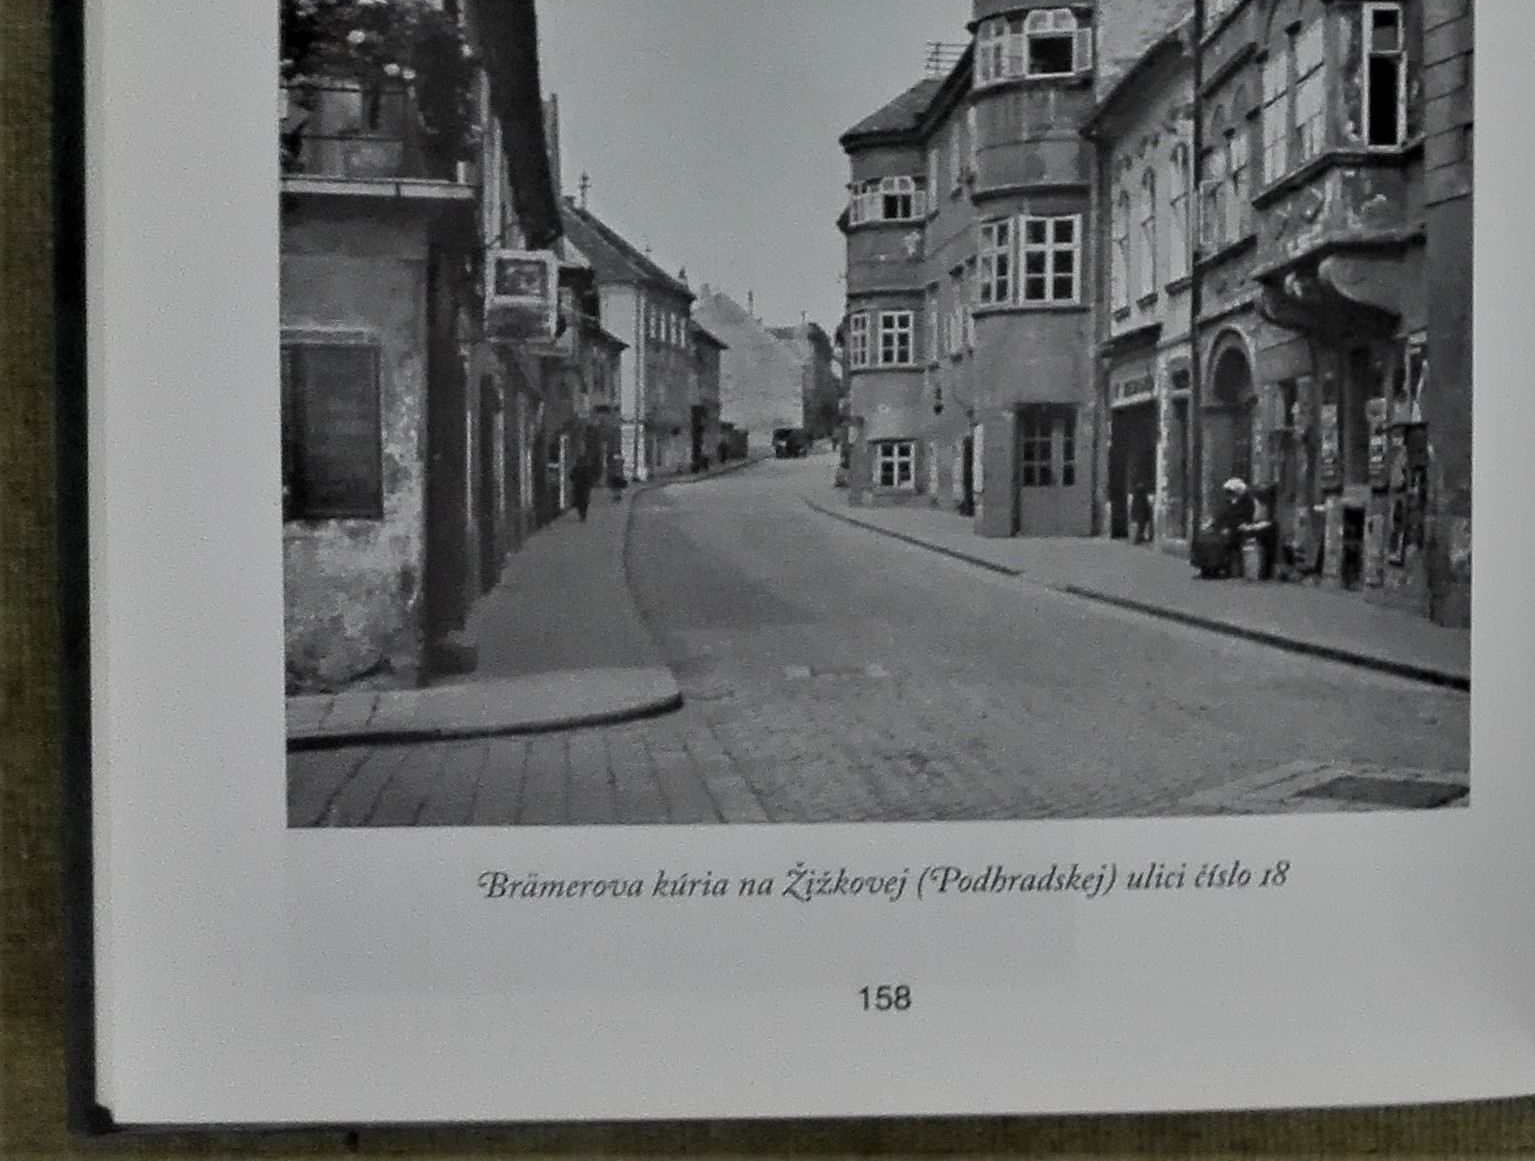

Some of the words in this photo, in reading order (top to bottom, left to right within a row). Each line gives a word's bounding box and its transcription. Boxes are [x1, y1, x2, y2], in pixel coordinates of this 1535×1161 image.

[477, 870, 645, 899] Brämerova
[651, 869, 730, 898] kúria
[738, 877, 775, 897] na
[781, 861, 910, 903] Žižkovej
[916, 862, 1118, 901] (Podhradskej)
[1126, 861, 1187, 891] ulici
[1193, 859, 1252, 889] číslo
[1258, 859, 1291, 888] 18
[858, 983, 913, 1013] 158
